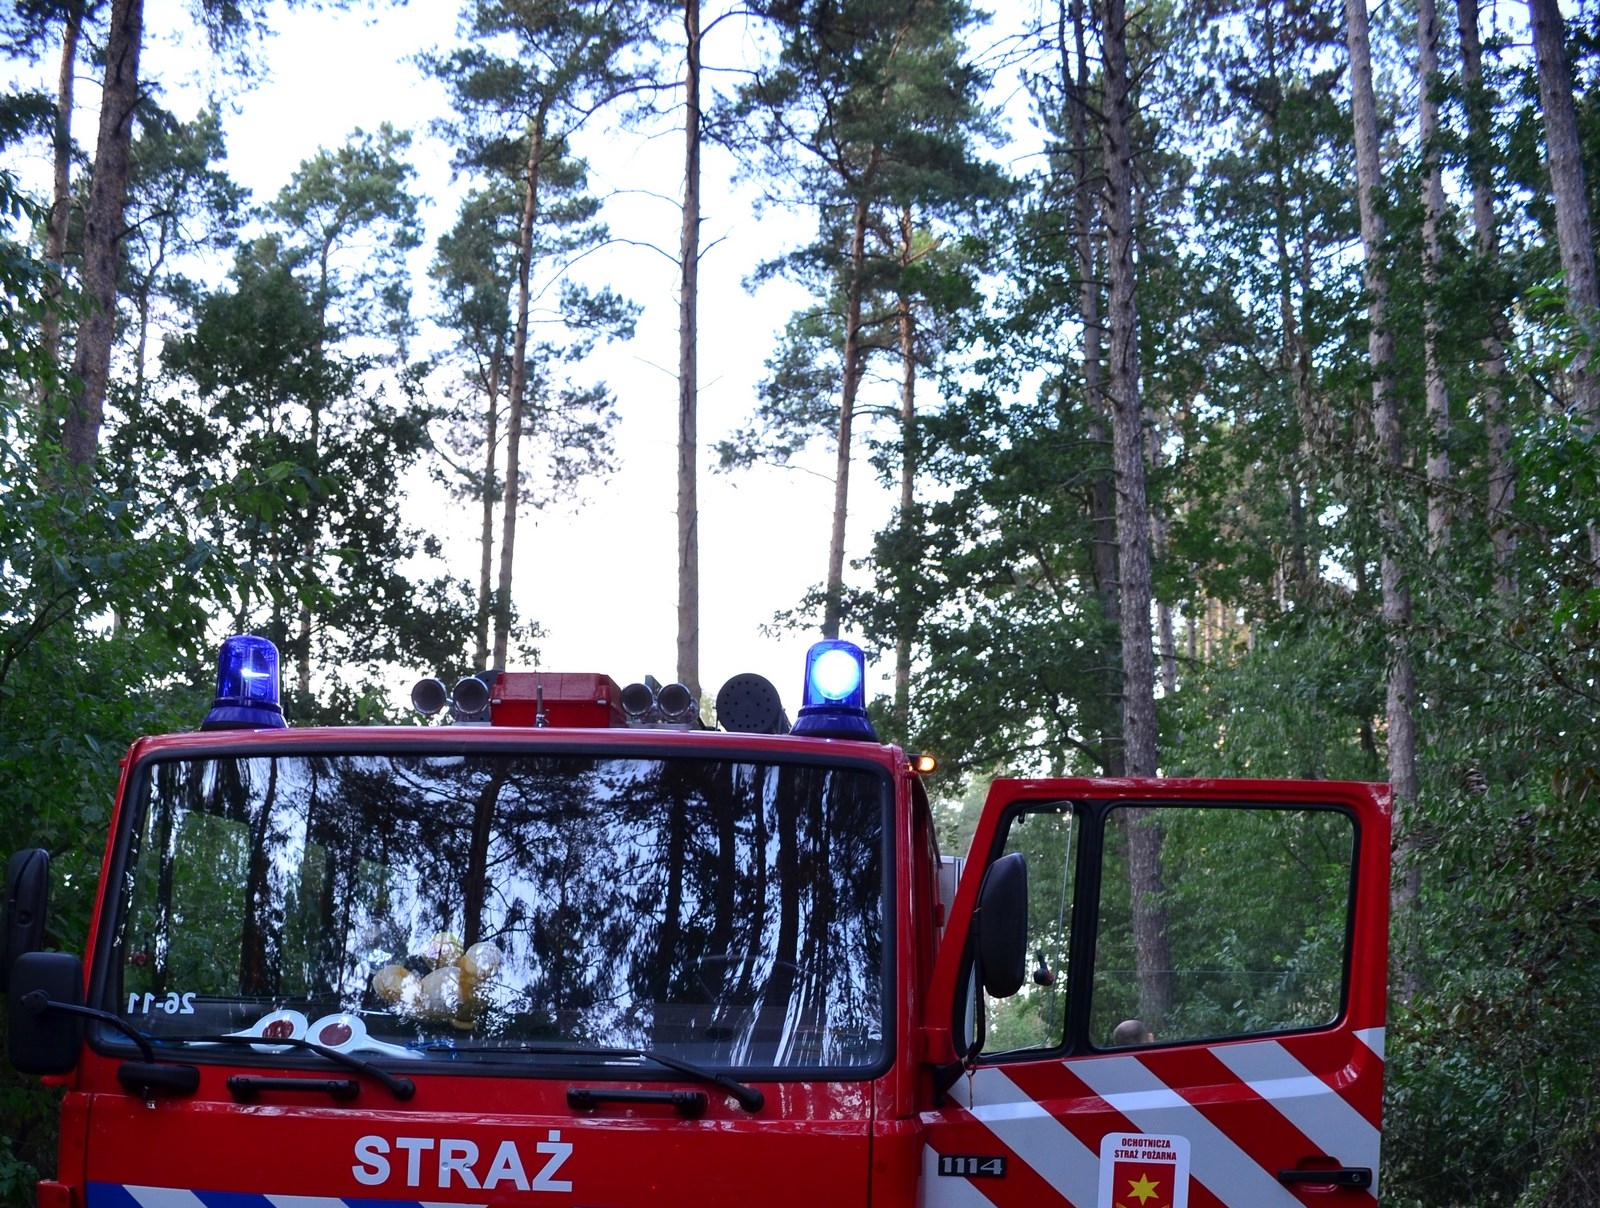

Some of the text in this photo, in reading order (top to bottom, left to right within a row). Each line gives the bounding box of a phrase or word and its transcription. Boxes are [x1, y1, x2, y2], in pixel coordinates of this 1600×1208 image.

[1121, 1138, 1171, 1148] OCHOTNICZA
[352, 1130, 574, 1192] STRAŻ
[1114, 1149, 1177, 1161] STRAŻ POŻARNA
[942, 1157, 1003, 1175] 1114
